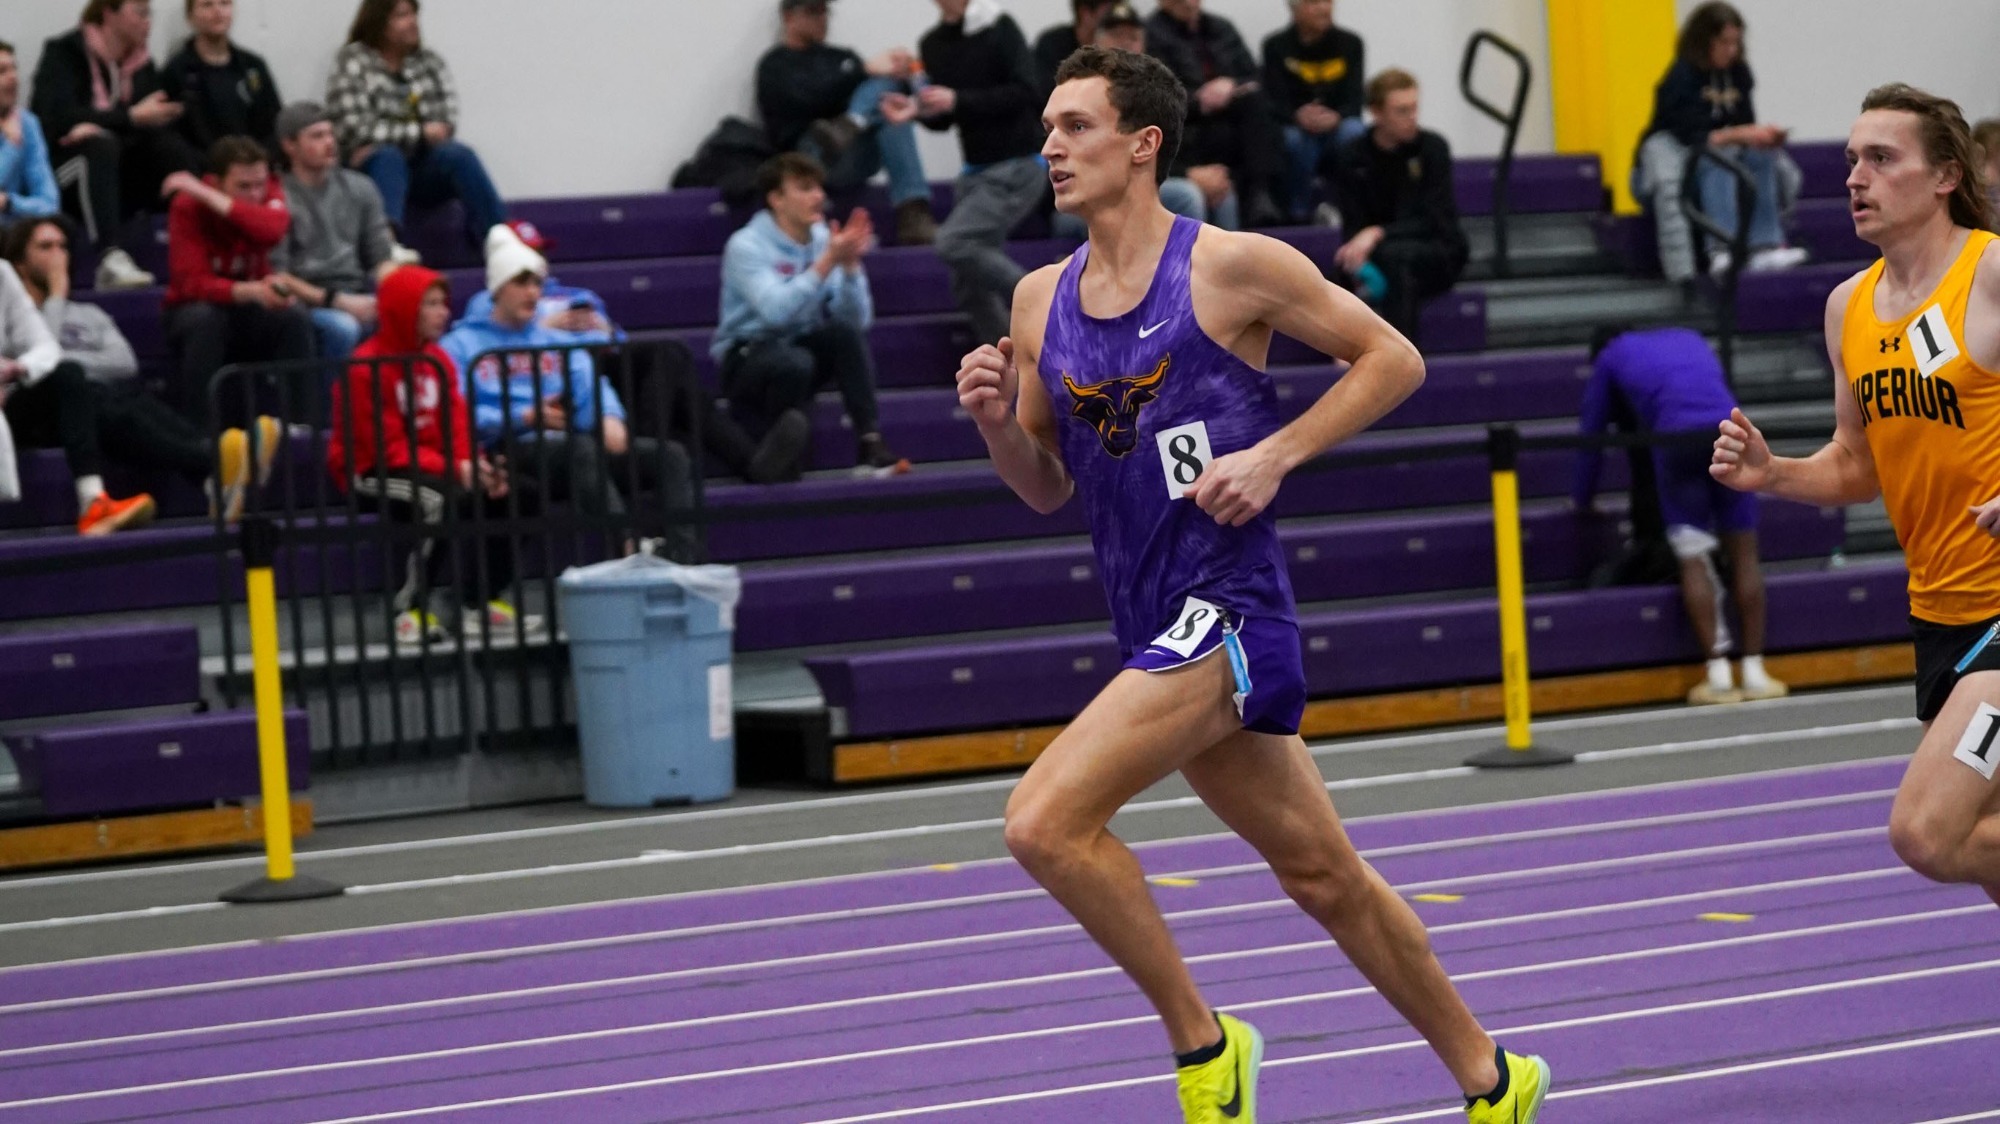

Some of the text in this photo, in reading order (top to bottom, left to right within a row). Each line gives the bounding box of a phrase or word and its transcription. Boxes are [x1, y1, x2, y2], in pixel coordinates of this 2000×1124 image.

[1914, 313, 1947, 364] 1
[1852, 367, 1967, 430] UPERIOR
[1168, 434, 1203, 485] 8
[1167, 608, 1209, 641] 8
[1967, 713, 2000, 764] 1
